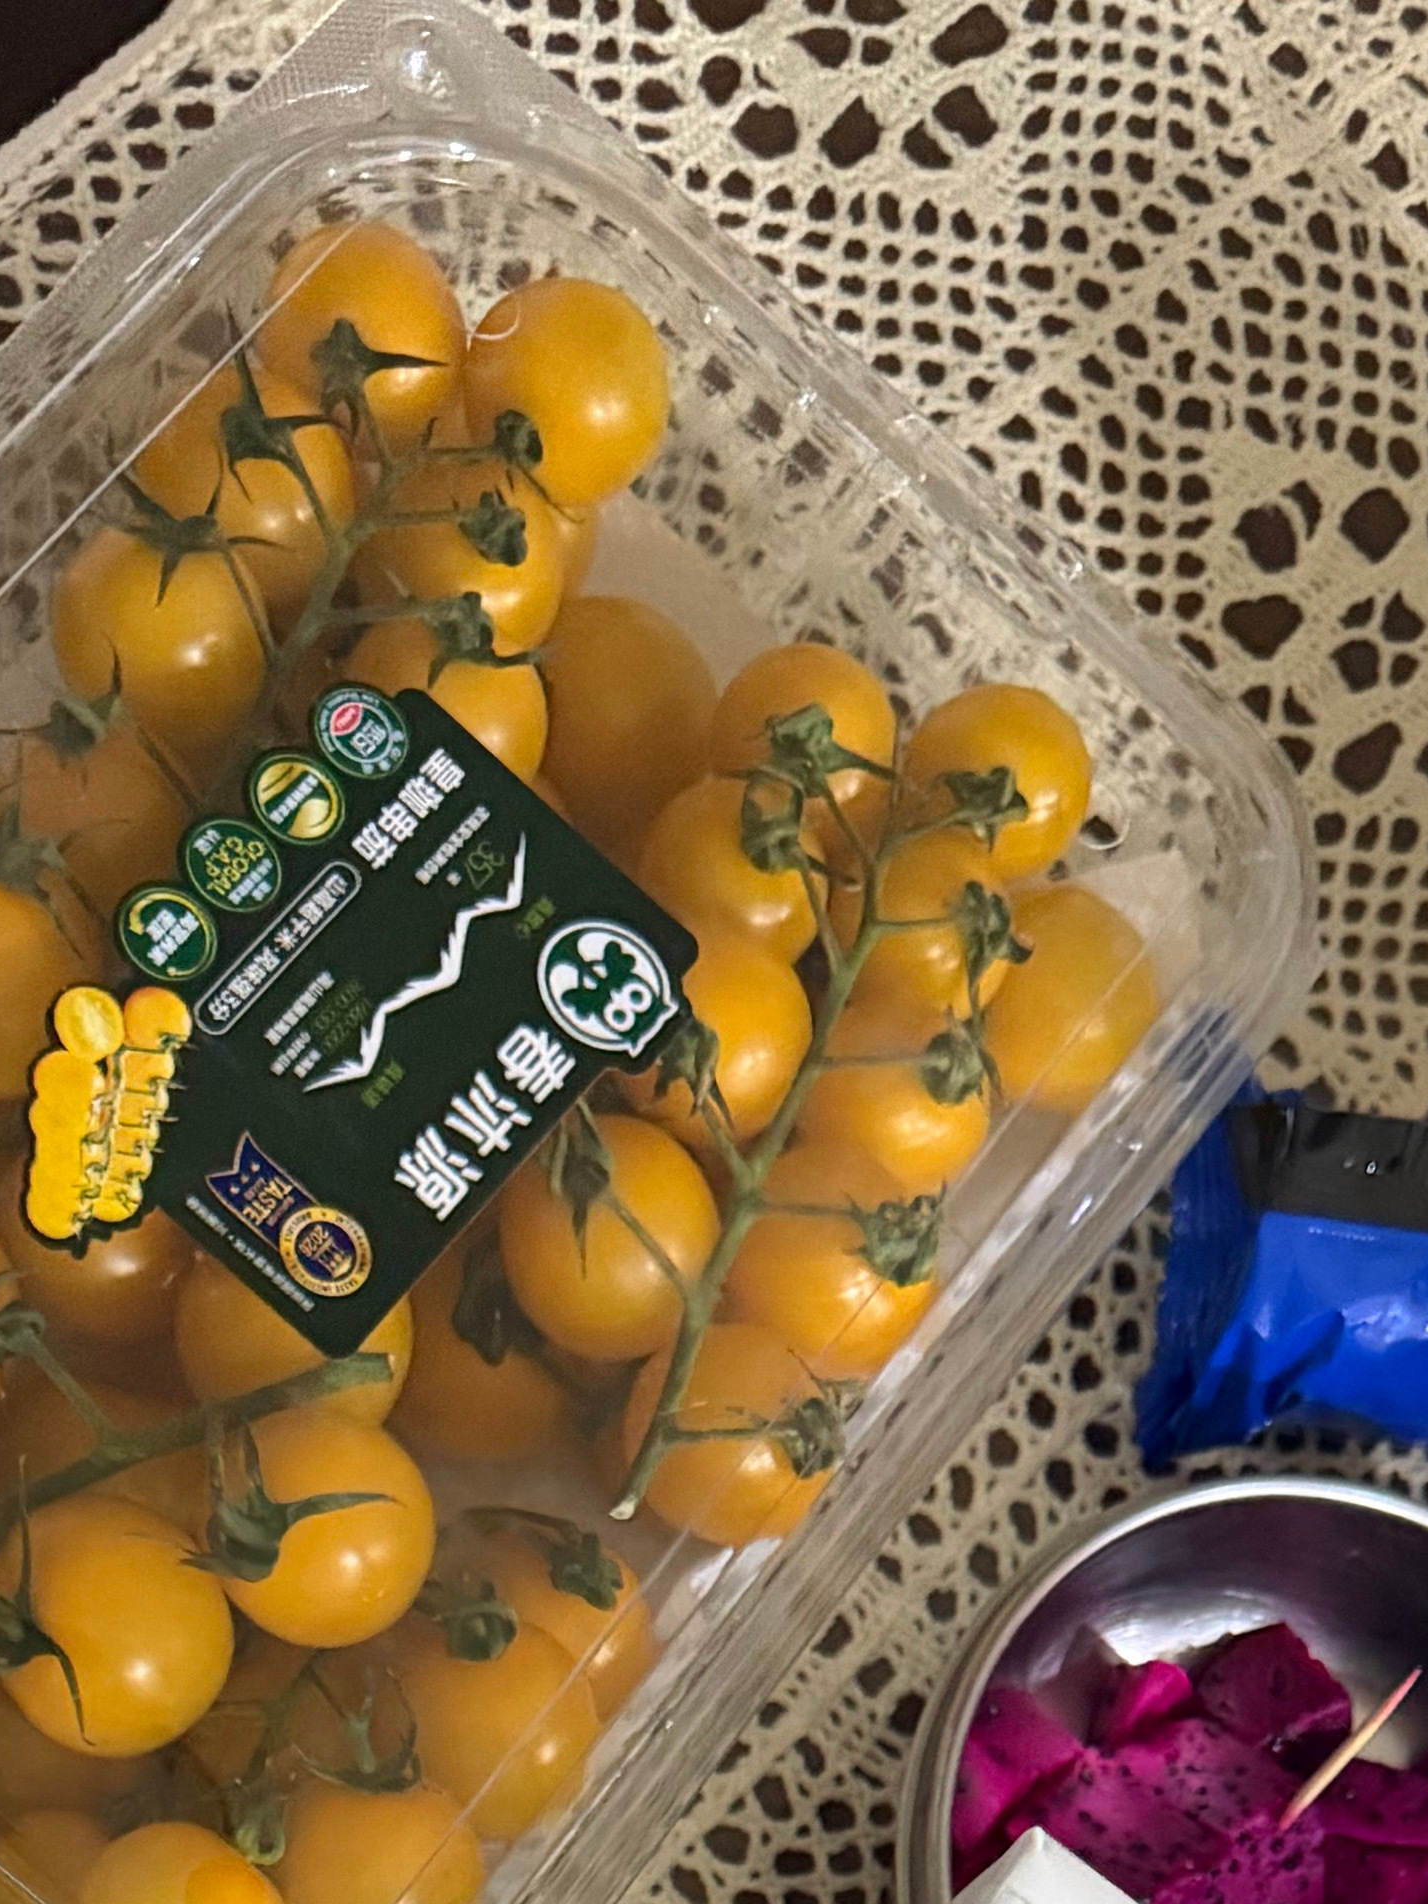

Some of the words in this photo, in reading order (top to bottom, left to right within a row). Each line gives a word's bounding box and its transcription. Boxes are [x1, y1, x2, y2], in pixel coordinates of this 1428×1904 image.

[391, 1022, 577, 1222] 春沐源
[240, 1172, 292, 1227] TASTE
